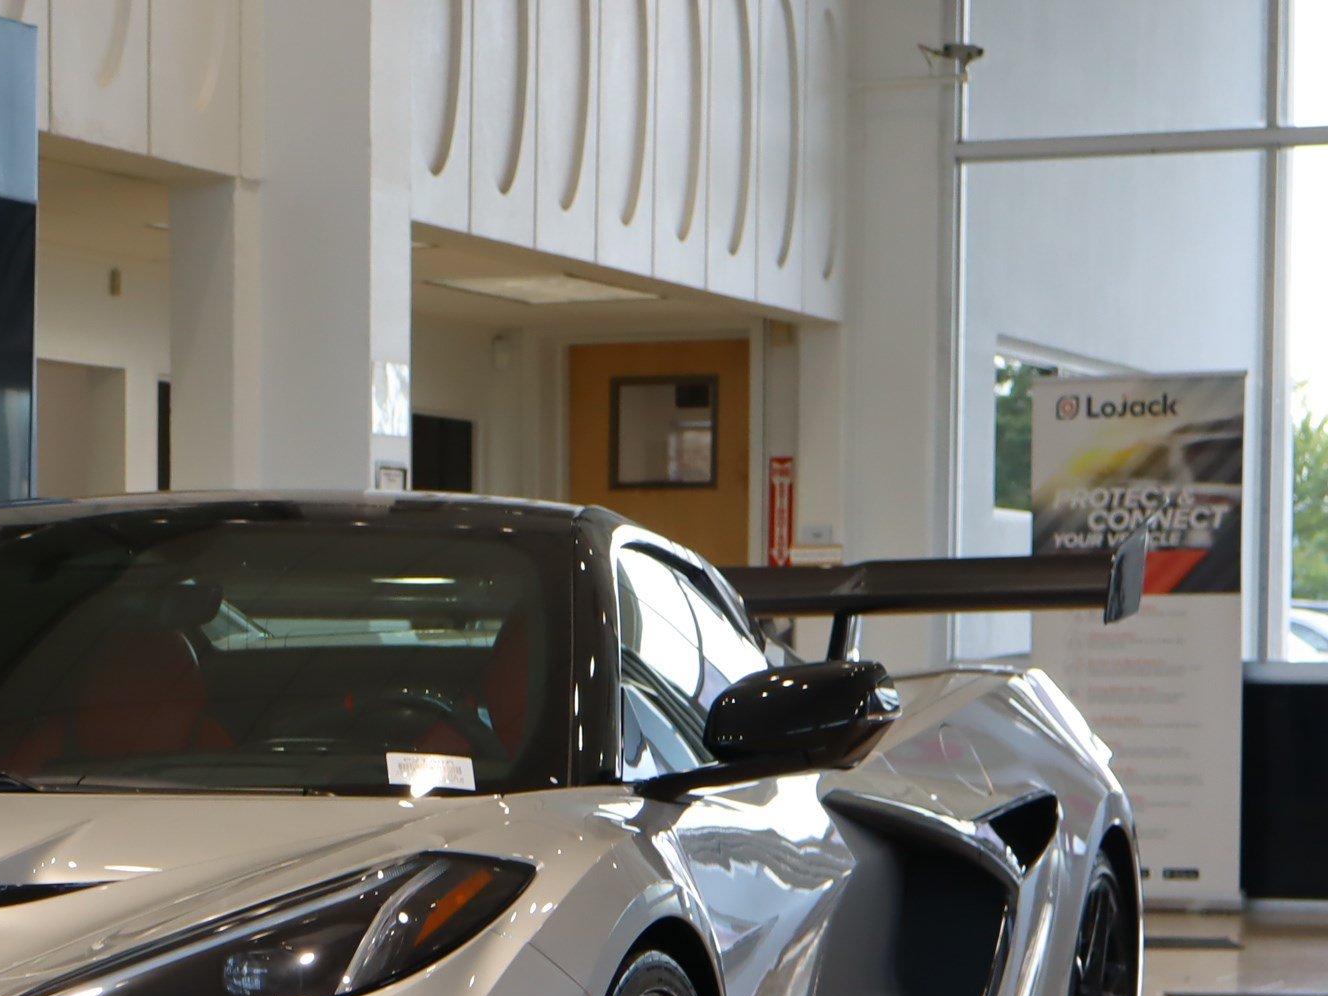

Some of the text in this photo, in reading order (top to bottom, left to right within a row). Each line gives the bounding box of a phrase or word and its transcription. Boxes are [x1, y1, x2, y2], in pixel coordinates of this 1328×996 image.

[1086, 393, 1177, 418] LoJack
[1053, 487, 1175, 509] PROTECT
[1087, 505, 1229, 532] CONNECT
[1054, 532, 1104, 548] YOUR
